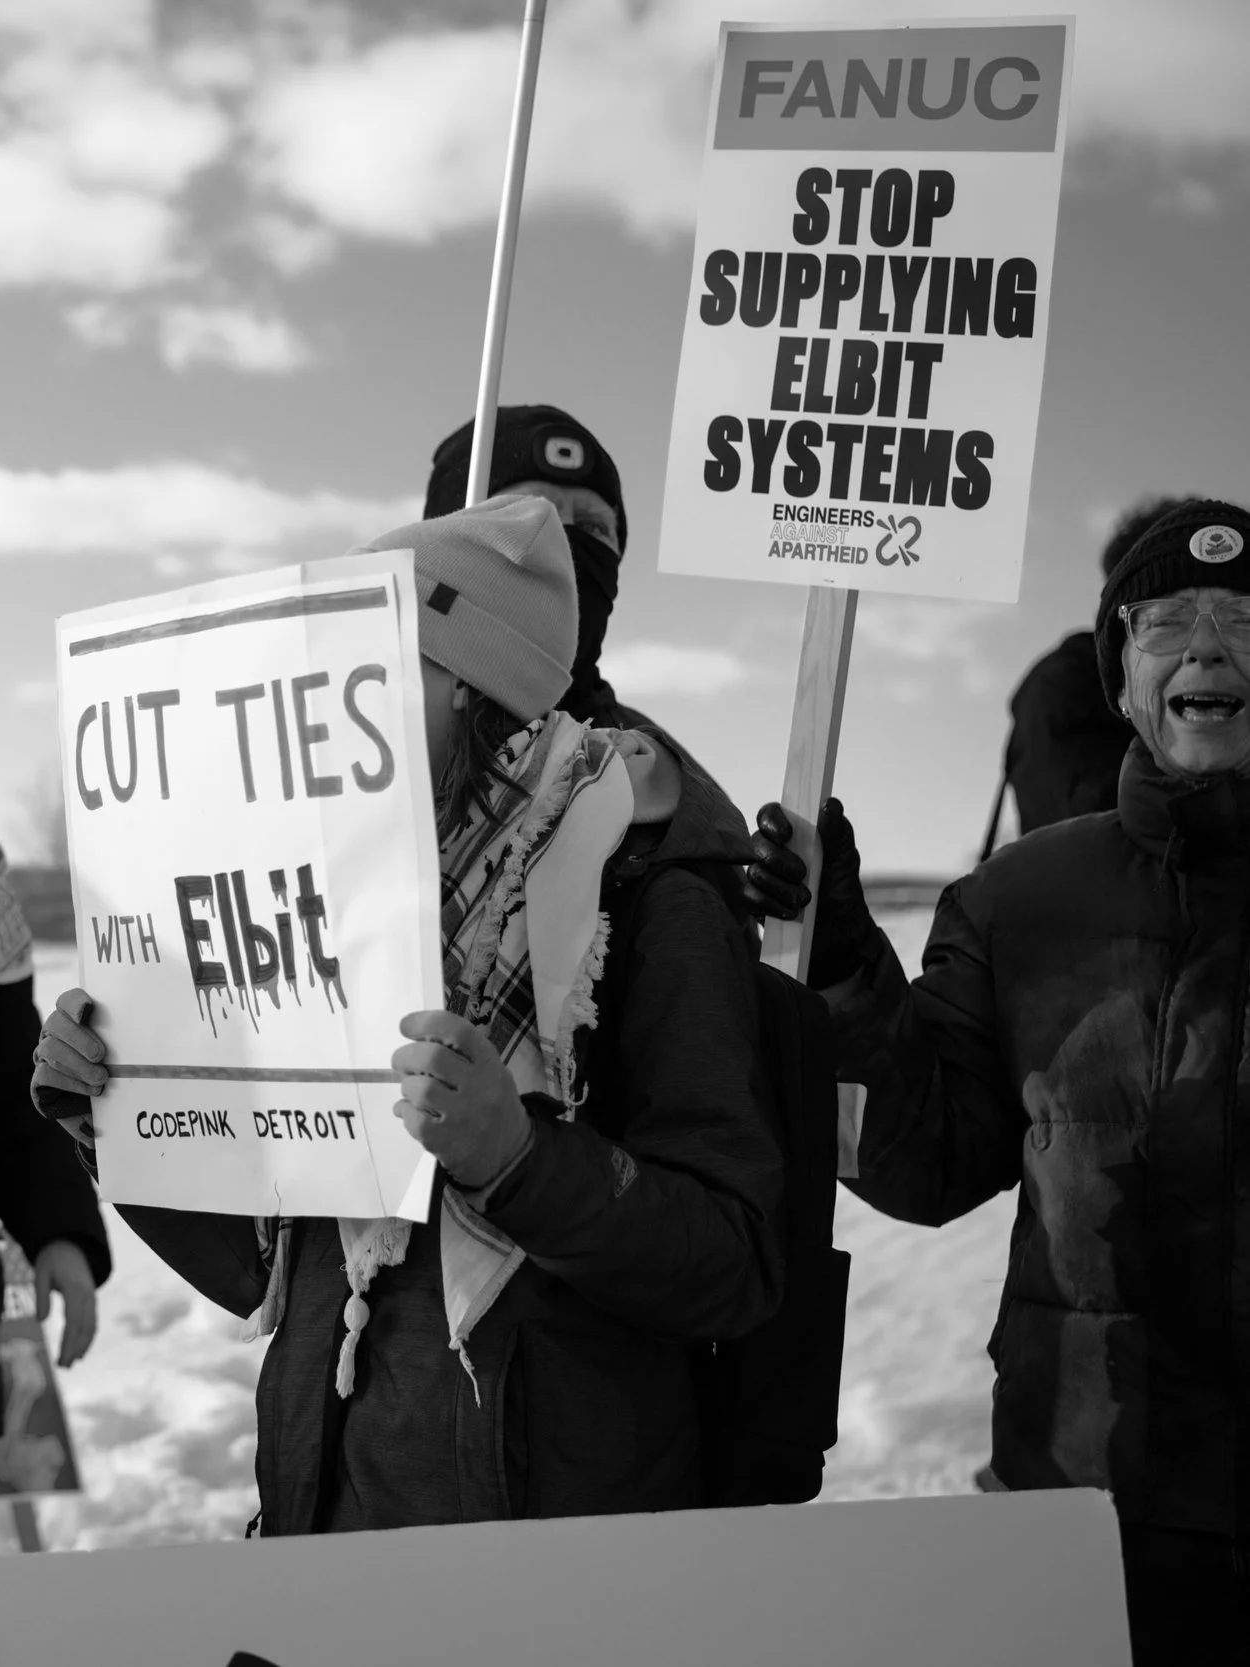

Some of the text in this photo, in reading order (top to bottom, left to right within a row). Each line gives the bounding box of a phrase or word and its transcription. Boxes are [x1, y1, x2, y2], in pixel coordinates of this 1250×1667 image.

[738, 57, 1041, 121] FANUC
[792, 167, 956, 248] STOP
[699, 249, 1038, 339] SUPPLYING
[770, 336, 945, 420] ELBIT
[703, 415, 995, 511] SYSTEMS
[768, 540, 869, 565] APARTHEID
[770, 522, 850, 545] AGAINST
[772, 503, 875, 528] ENGINEERS
[74, 663, 395, 811] CUT TIES
[91, 863, 348, 1034] WITH Elbit
[136, 1109, 356, 1142] CODEPINK DETROIT
